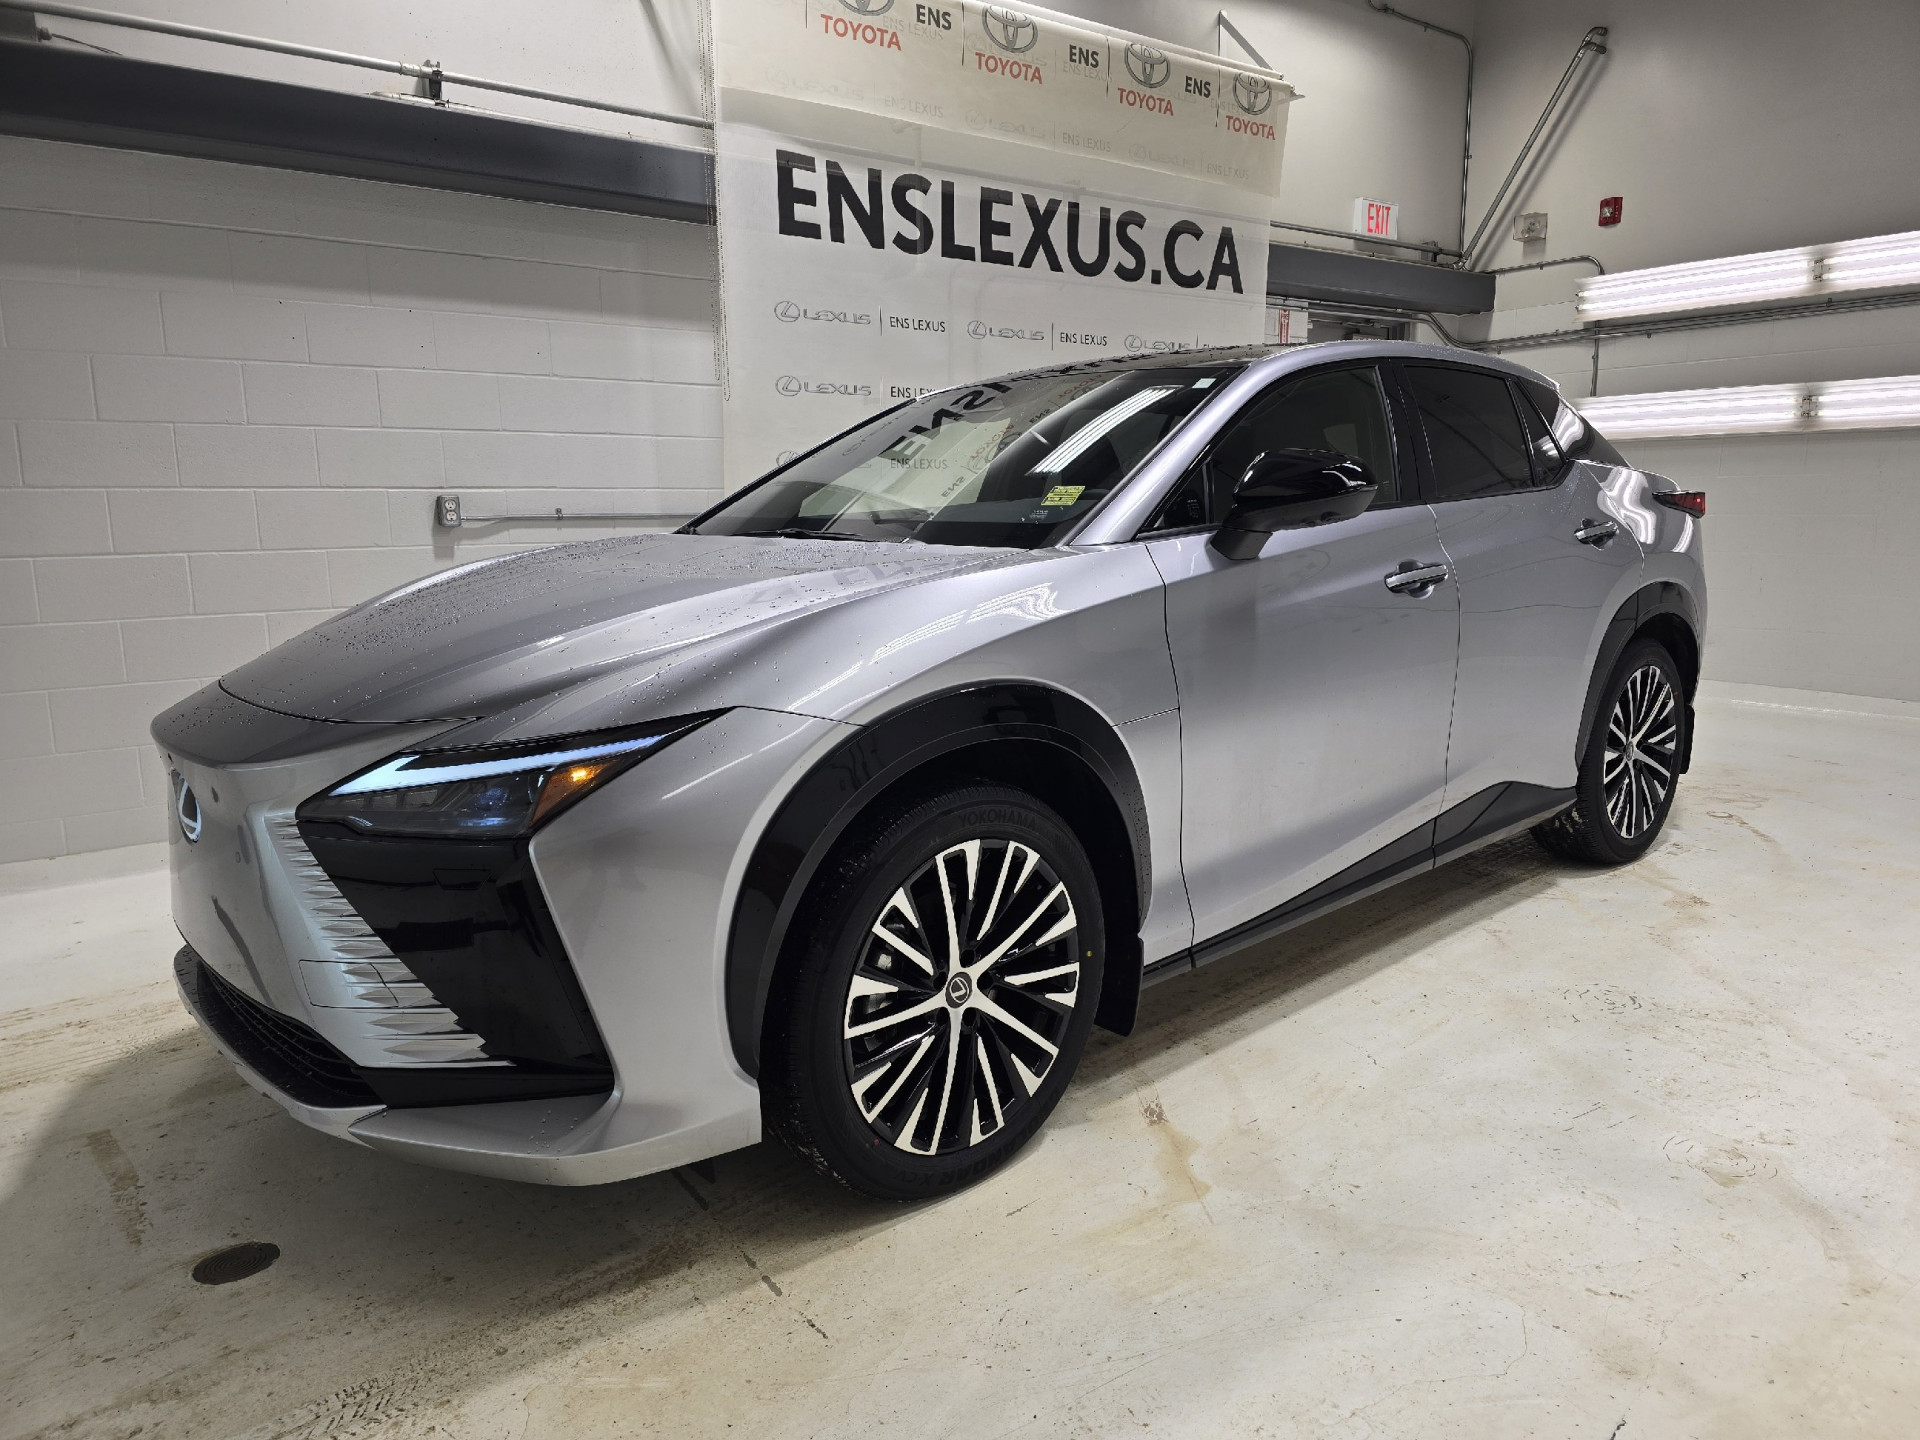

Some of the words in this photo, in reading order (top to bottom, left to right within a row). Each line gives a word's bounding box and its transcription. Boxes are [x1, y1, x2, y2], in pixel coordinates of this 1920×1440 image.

[916, 4, 952, 30] ENS
[821, 14, 902, 51] TOYOTA
[1069, 44, 1100, 69] ENS
[975, 52, 1043, 85] TOYOTA
[1185, 76, 1212, 99] ENS
[1118, 88, 1174, 116] TOYOTA
[1062, 132, 1081, 147] ENS
[1226, 115, 1276, 141] TOYOTA
[776, 149, 1244, 294] ENSLEXUS.CA
[1367, 203, 1391, 236] EXIT
[803, 308, 872, 325] LEXUS
[889, 316, 910, 329] ENS
[912, 318, 946, 333] LEXUS
[989, 327, 1044, 341] LEXUS
[1060, 332, 1077, 345] ENS
[1080, 333, 1108, 347] LEXUS
[803, 382, 872, 396] LEXUS
[890, 386, 911, 398] ENS
[913, 459, 948, 470] LEXUS
[958, 808, 1037, 831] YOKOHAMA
